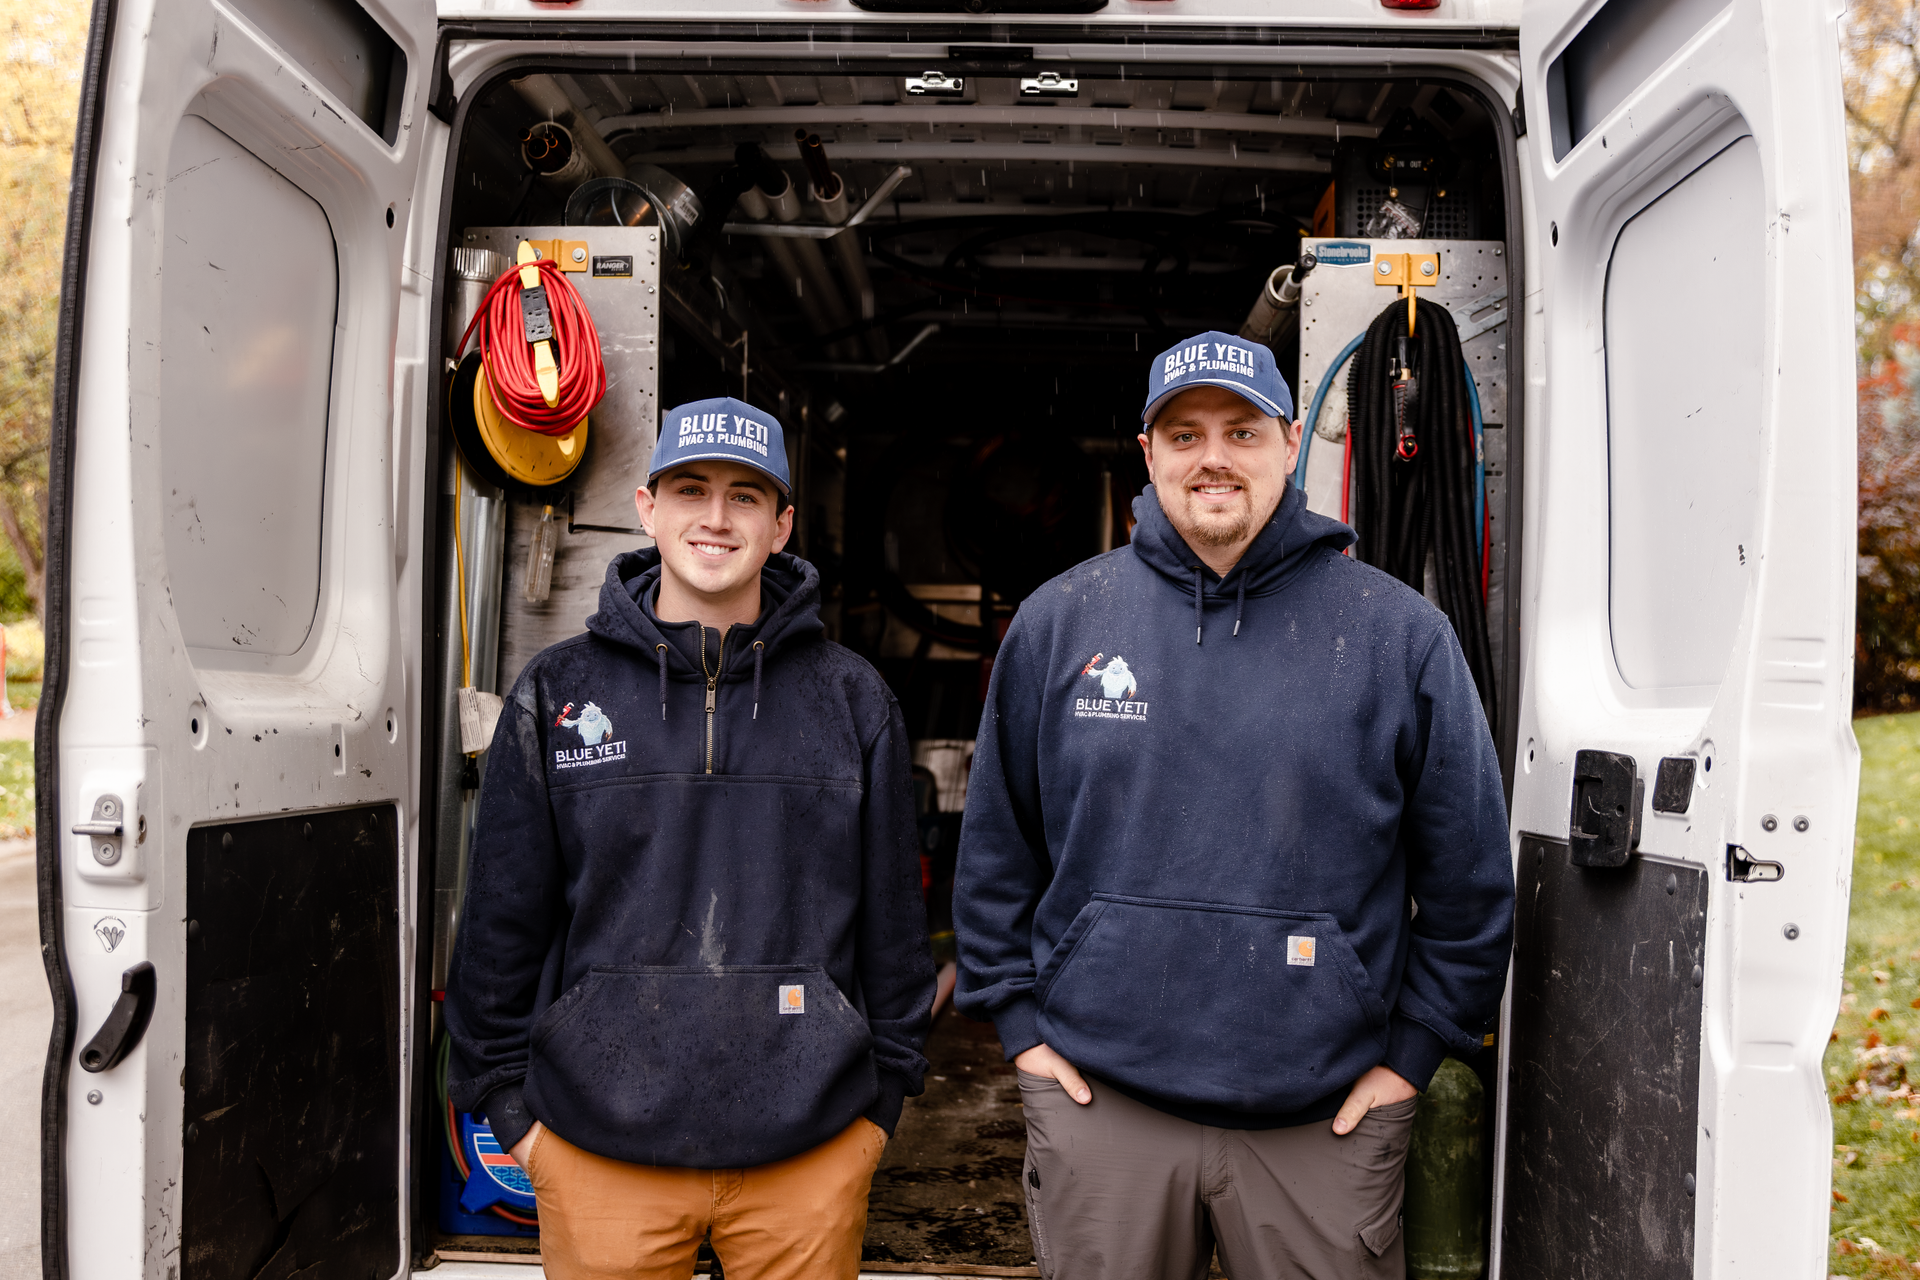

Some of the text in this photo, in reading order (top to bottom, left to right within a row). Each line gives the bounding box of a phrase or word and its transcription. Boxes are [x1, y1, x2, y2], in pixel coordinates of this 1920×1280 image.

[1396, 160, 1422, 168] IN OUT
[1318, 245, 1369, 258] Stonebrooke
[1164, 342, 1254, 374] BLUE YETI
[1164, 360, 1254, 386] HVAC & PLUMBING
[679, 413, 769, 446] BLUE YETI
[678, 433, 768, 458] HVAC & PLUMBING
[1076, 698, 1148, 715] BLUE YETI
[1120, 713, 1147, 721] SERVICES
[555, 740, 627, 763] BLUE YETI
[556, 762, 572, 770] HVAC
[575, 758, 602, 768] PLUMBING
[602, 753, 626, 763] SERVICES
